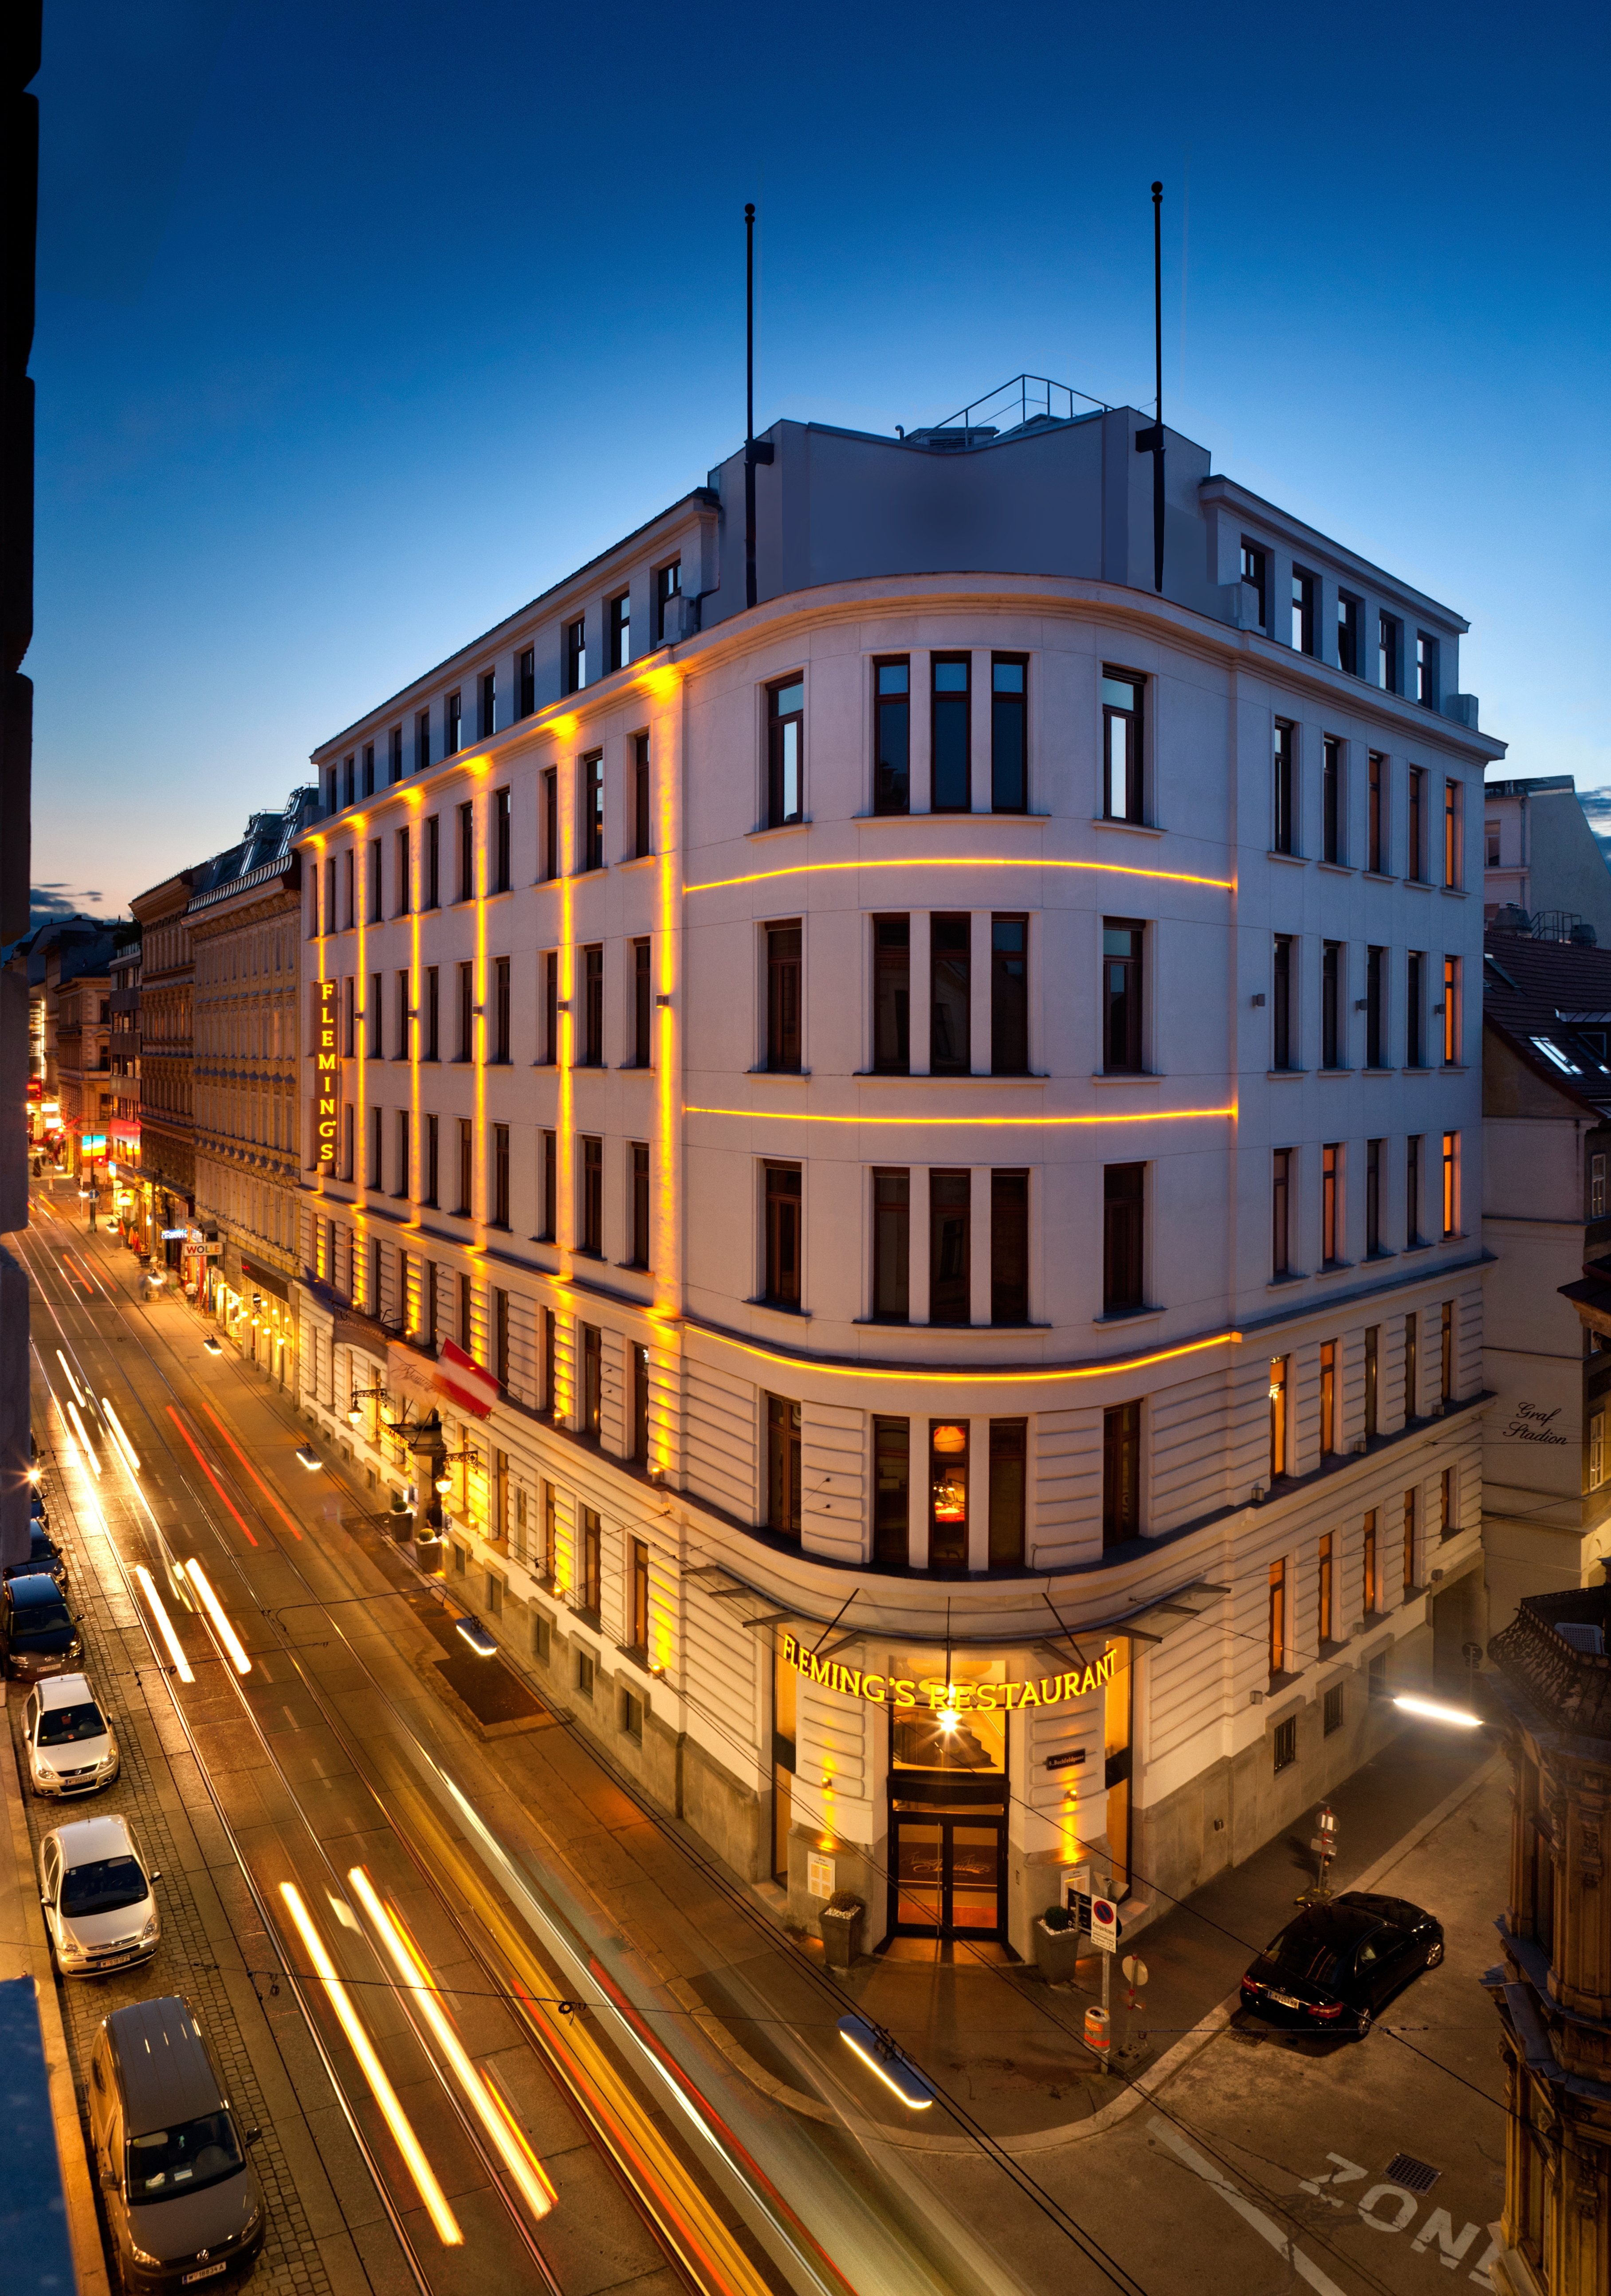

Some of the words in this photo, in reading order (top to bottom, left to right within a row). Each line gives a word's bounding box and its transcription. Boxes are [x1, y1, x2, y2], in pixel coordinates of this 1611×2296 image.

[318, 984, 337, 1160] FLEMING'S
[186, 1245, 220, 1254] WOLLE
[1516, 1402, 1562, 1427] Graf
[1502, 1421, 1568, 1445] Stadion
[783, 1633, 916, 1707] FLEMING'S
[927, 1648, 1117, 1712] RESTAURANT
[199, 2266, 218, 2277] 18834
